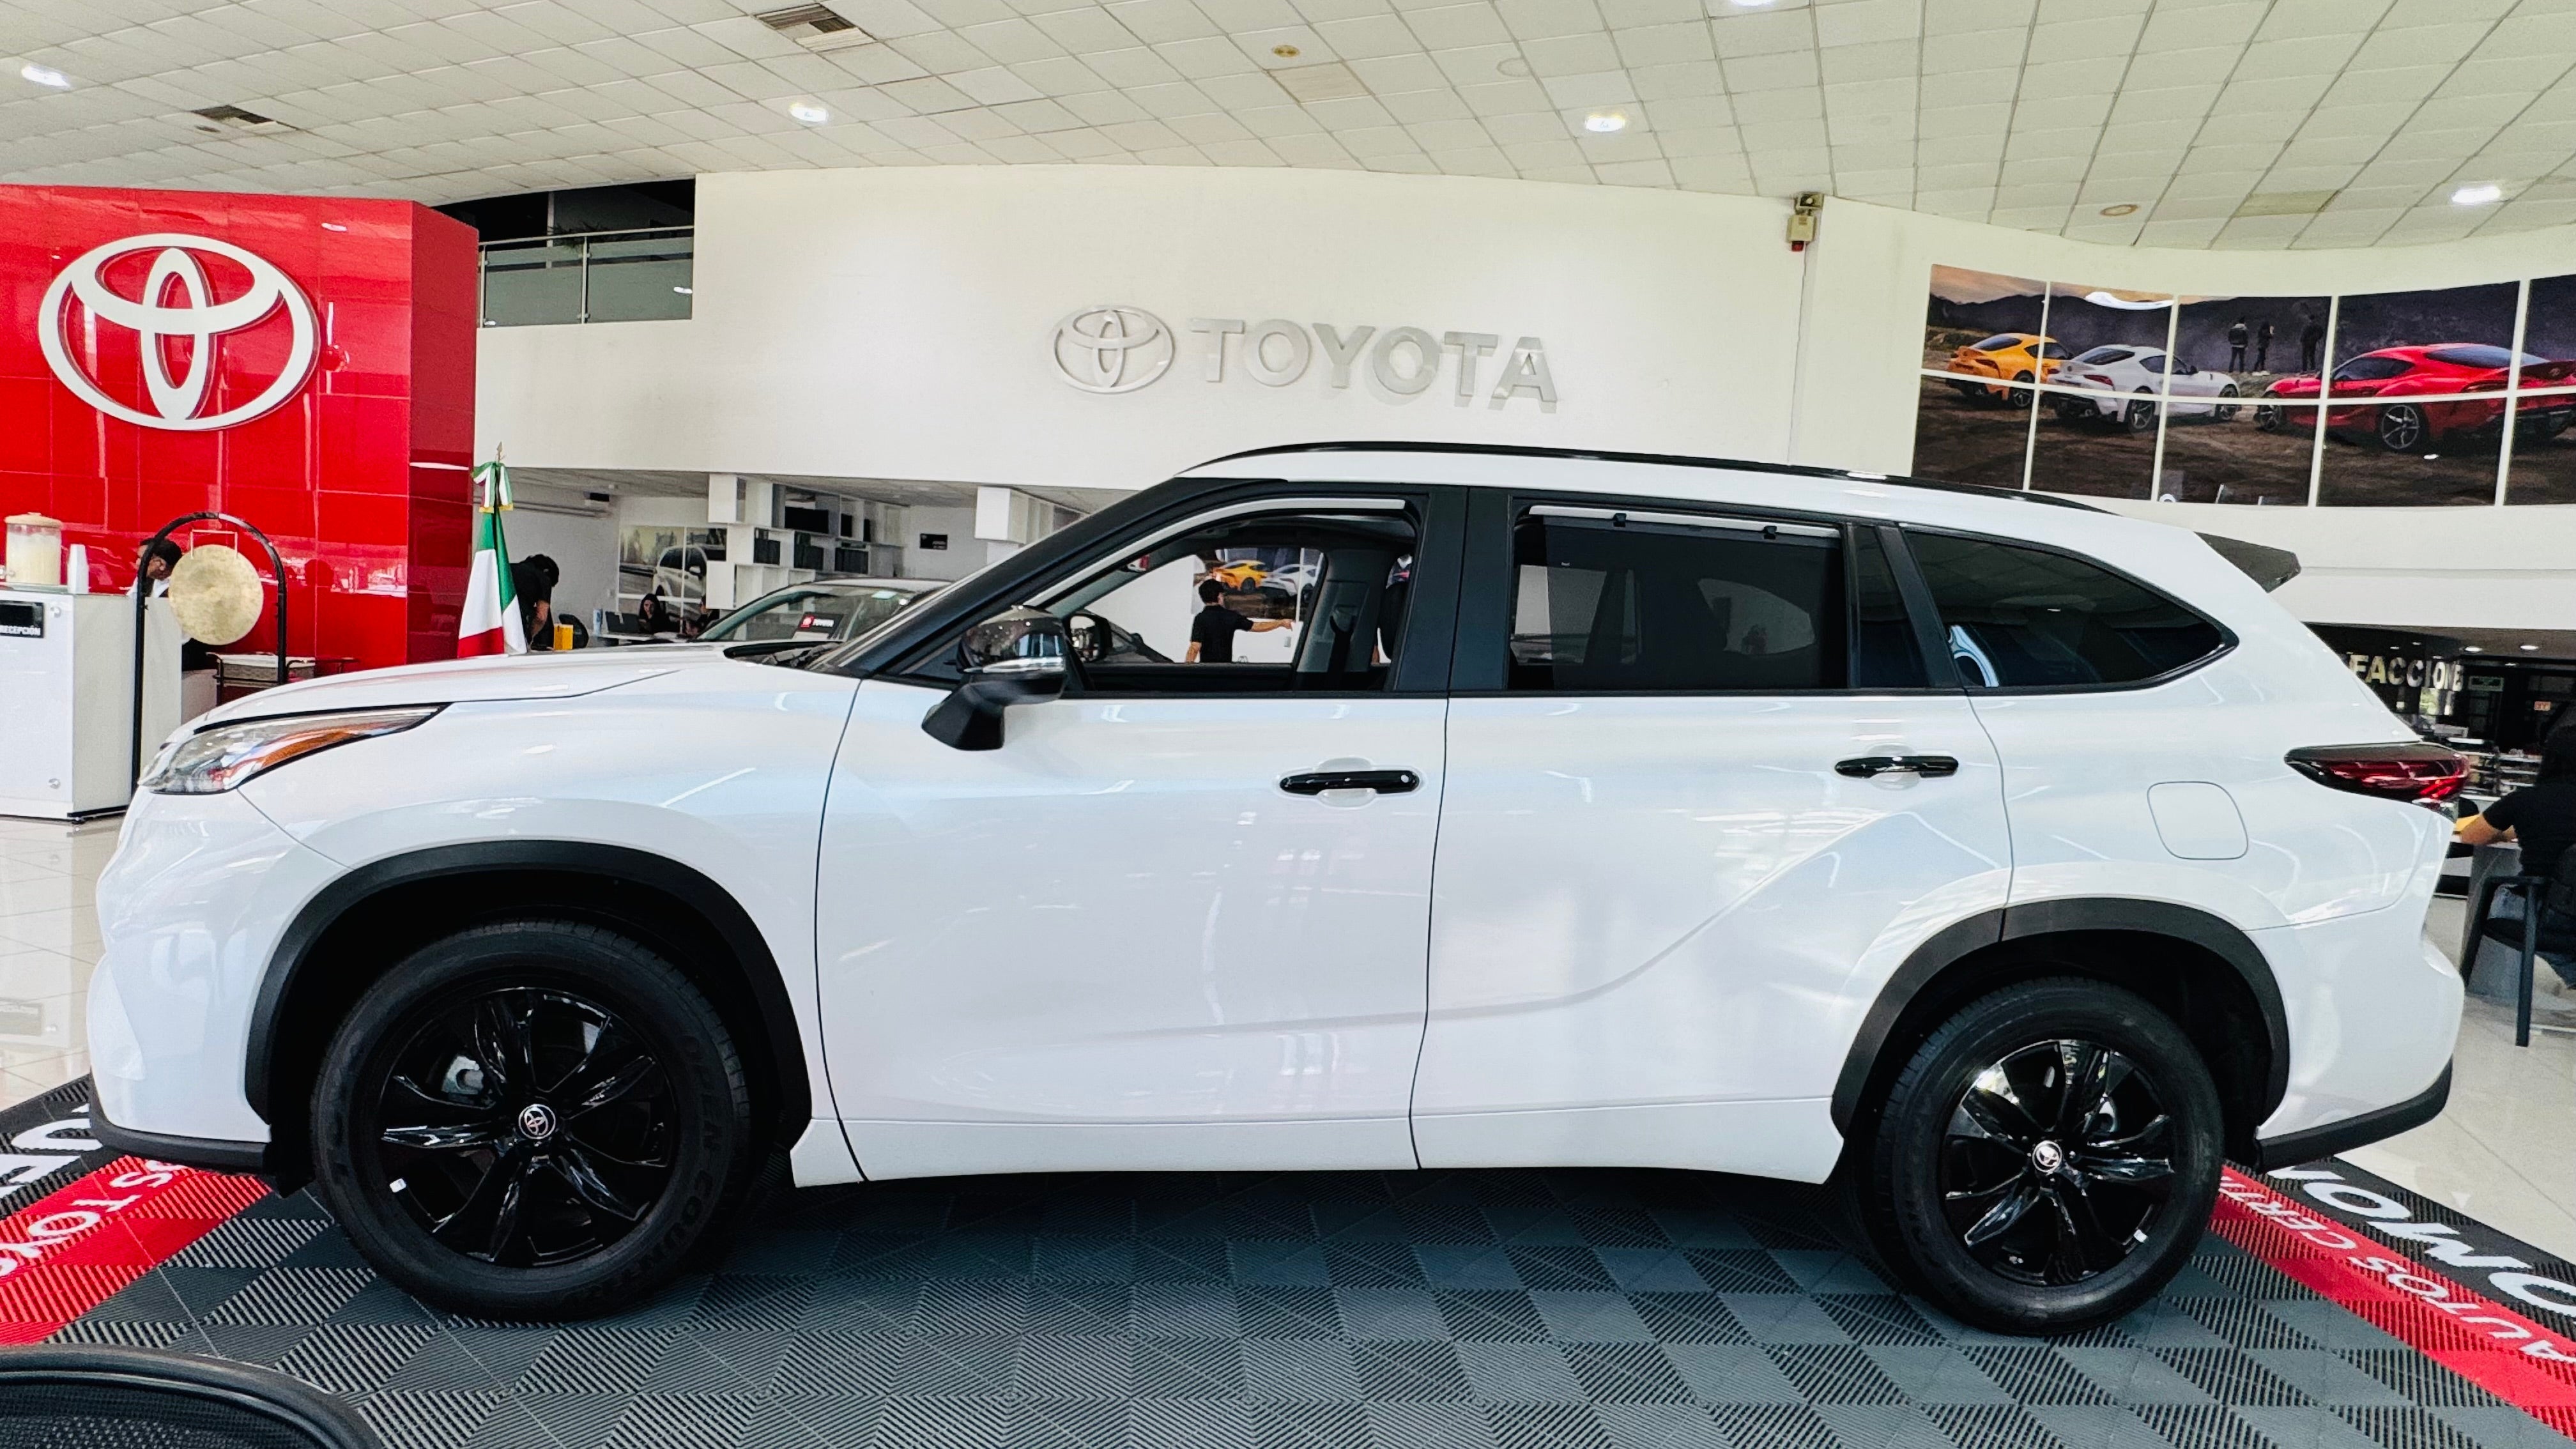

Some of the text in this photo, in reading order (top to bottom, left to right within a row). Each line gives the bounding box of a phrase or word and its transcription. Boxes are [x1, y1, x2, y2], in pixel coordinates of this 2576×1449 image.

[1190, 318, 1558, 404] TOYOTA
[2218, 1176, 2576, 1364] AUTOS CERTI
